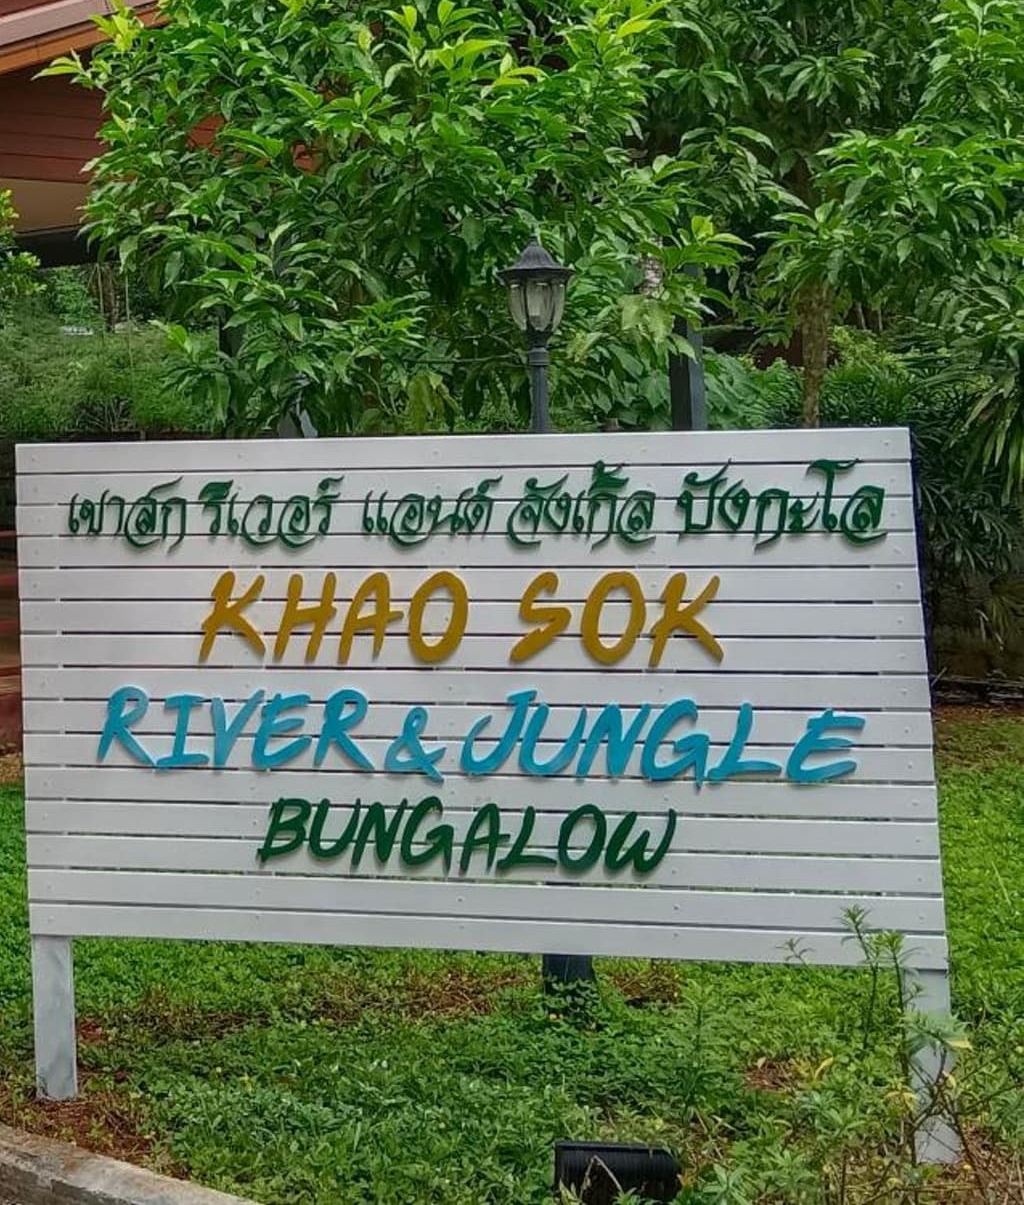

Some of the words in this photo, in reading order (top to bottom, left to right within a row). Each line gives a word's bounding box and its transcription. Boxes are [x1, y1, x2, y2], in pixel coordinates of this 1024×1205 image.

[67, 476, 187, 553] เขาสก
[361, 475, 504, 548] แอนด์
[676, 457, 888, 552] บังกะโล
[198, 571, 470, 664] KHAO
[510, 570, 724, 668] SOK
[97, 686, 374, 772] RIVER
[384, 705, 447, 783] &
[459, 689, 866, 789] JUNGLE
[257, 794, 678, 876] BUNGALOW
